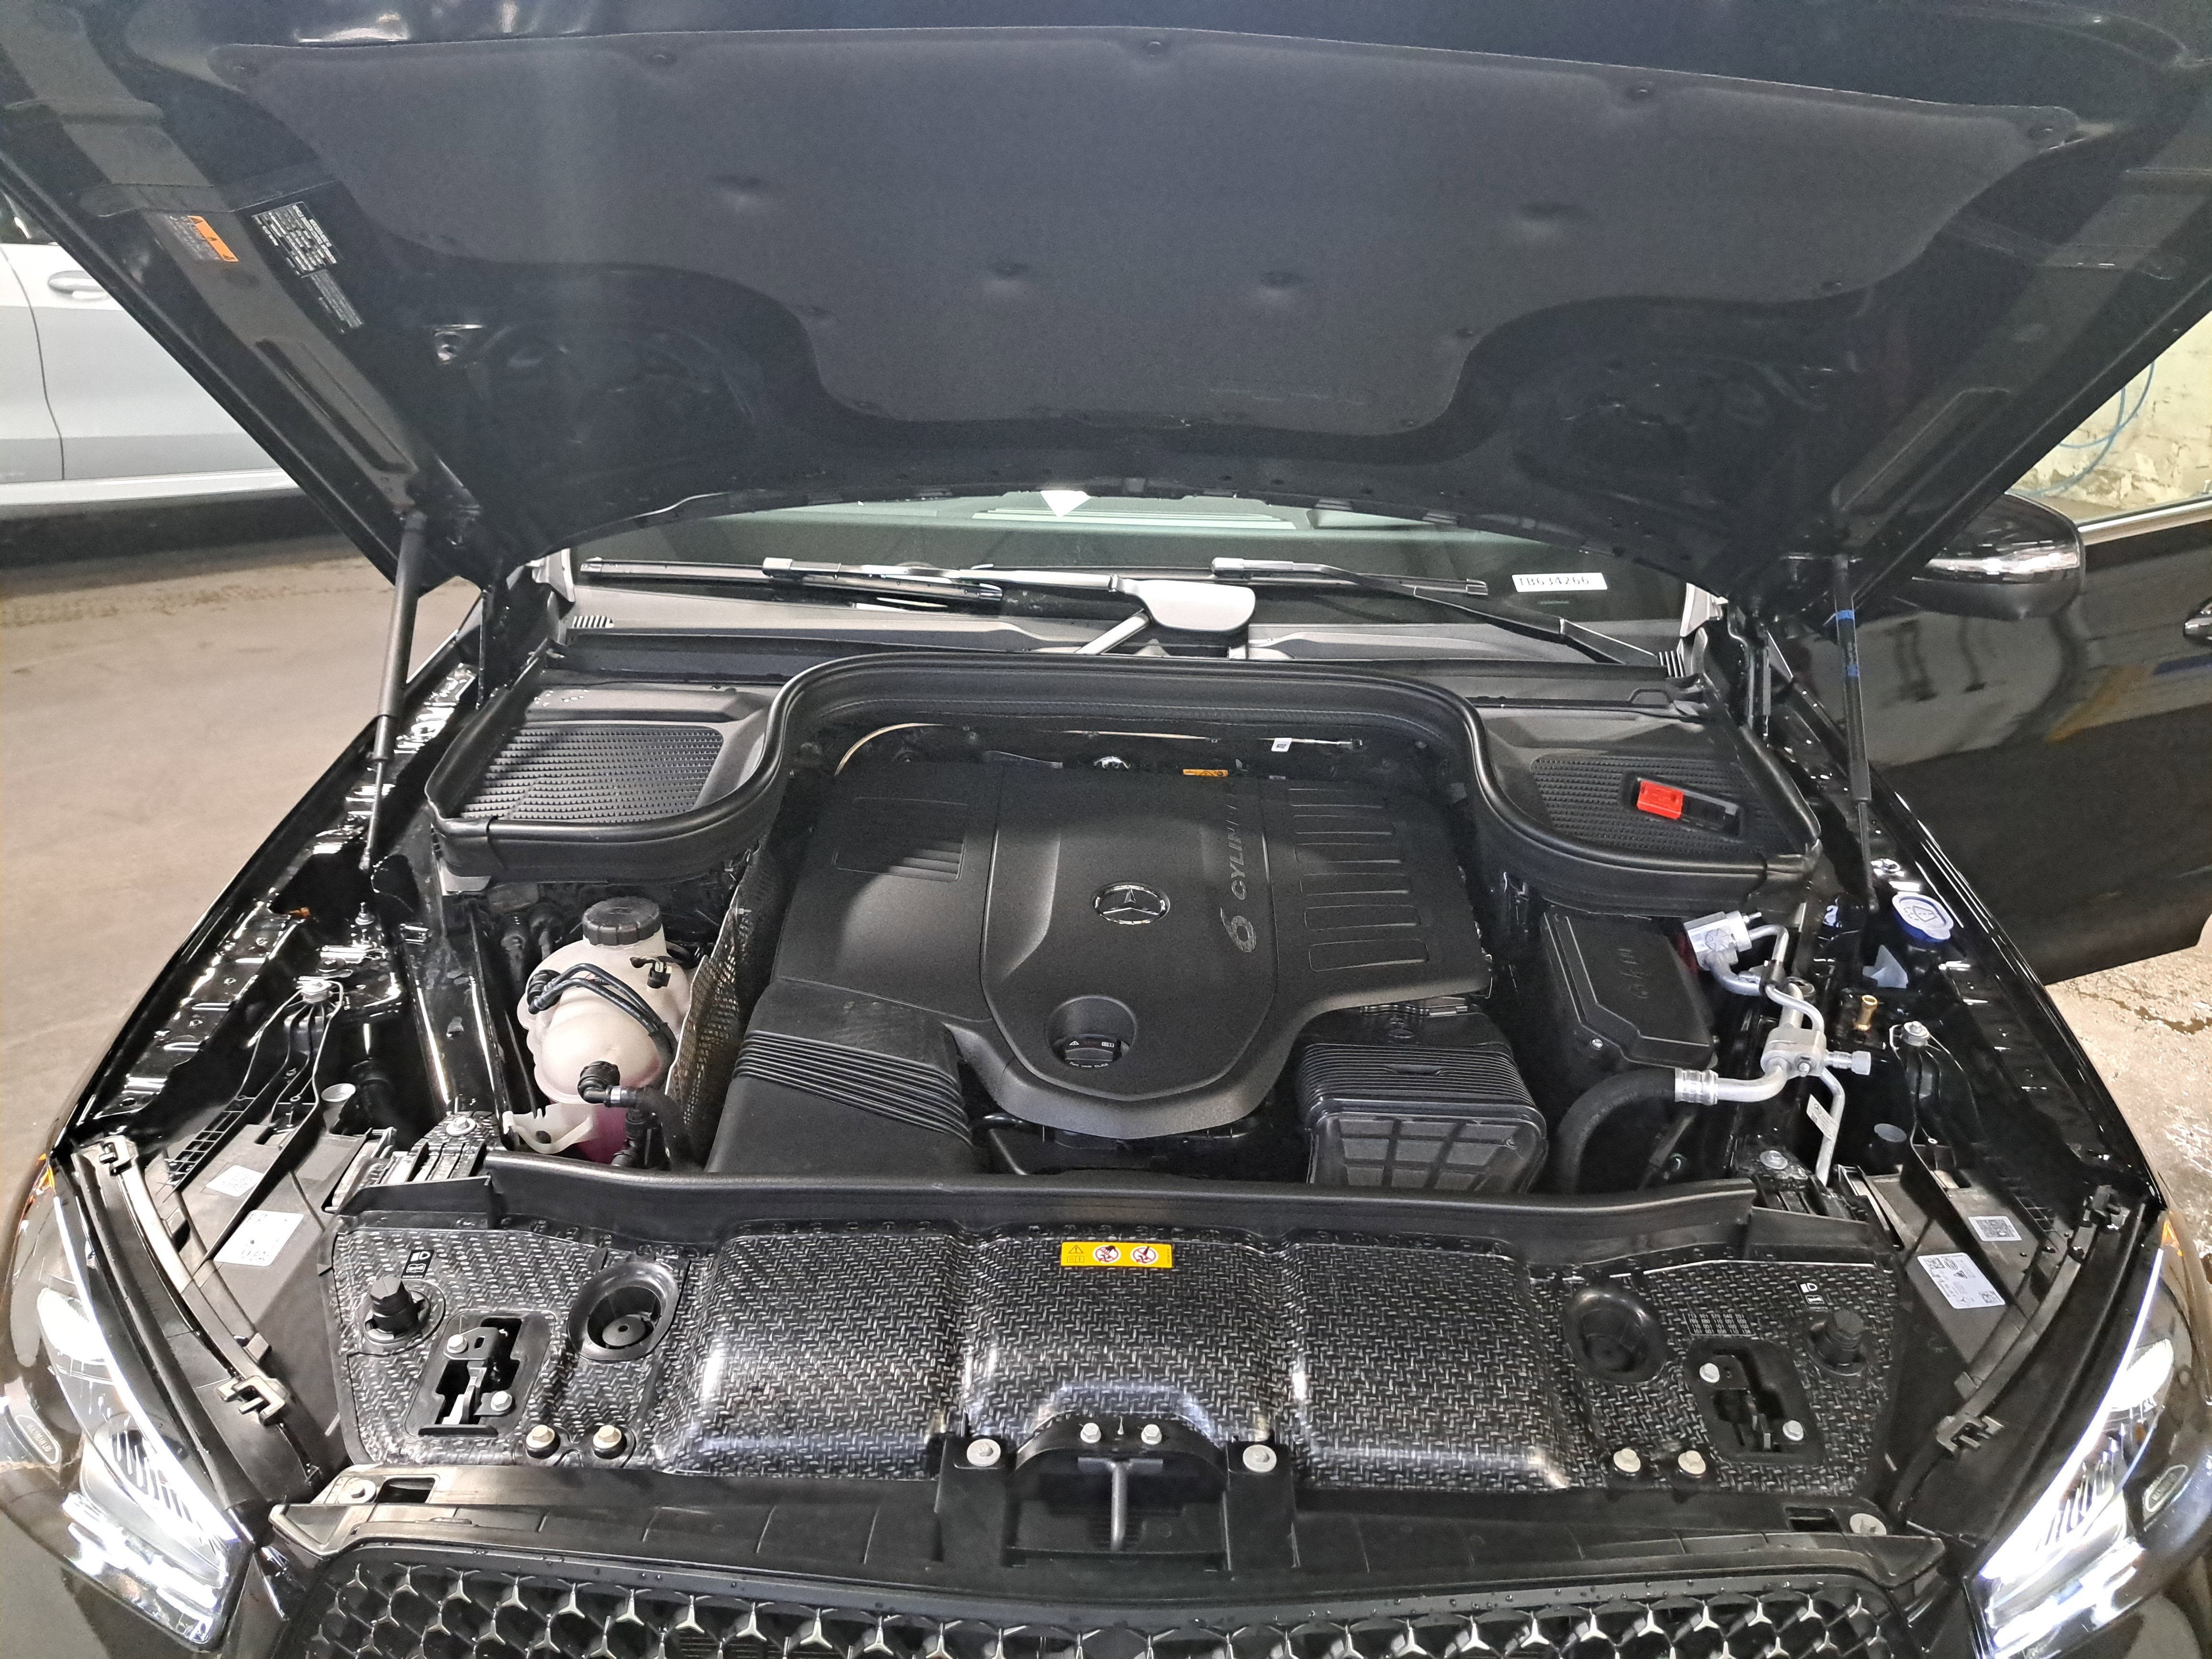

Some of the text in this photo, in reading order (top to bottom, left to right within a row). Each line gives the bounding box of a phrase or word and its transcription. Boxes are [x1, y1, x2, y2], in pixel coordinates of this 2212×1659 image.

[1518, 576, 1589, 586] TB634266
[1219, 795, 1257, 953] 6 CYLIN
